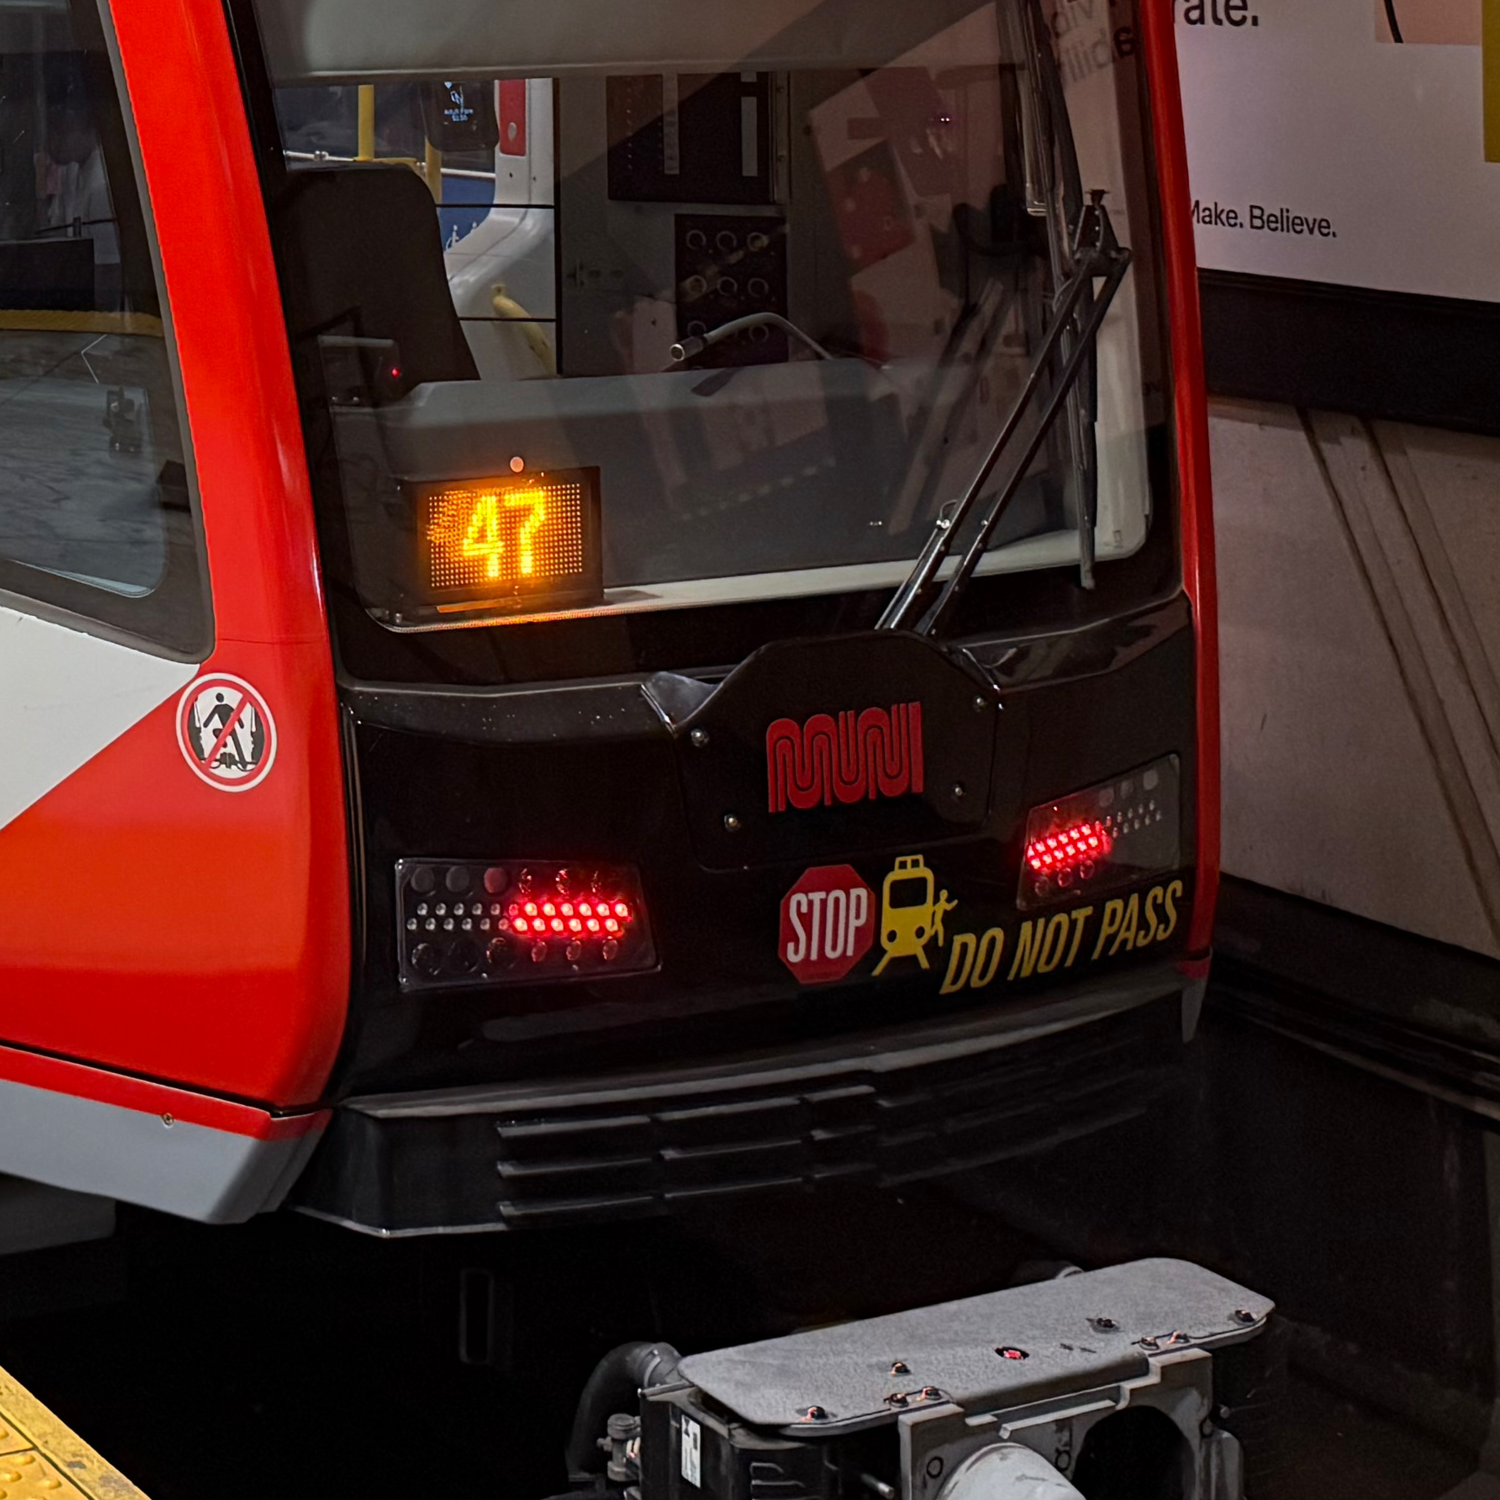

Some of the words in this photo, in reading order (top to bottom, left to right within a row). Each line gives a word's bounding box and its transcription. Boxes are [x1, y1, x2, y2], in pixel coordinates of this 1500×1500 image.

[1249, 204, 1338, 238] Believe.
[463, 490, 546, 578] 47
[786, 887, 868, 963] STOP
[939, 926, 1003, 995] DO
[1007, 905, 1094, 982] NOT
[1091, 880, 1183, 961] PASS
